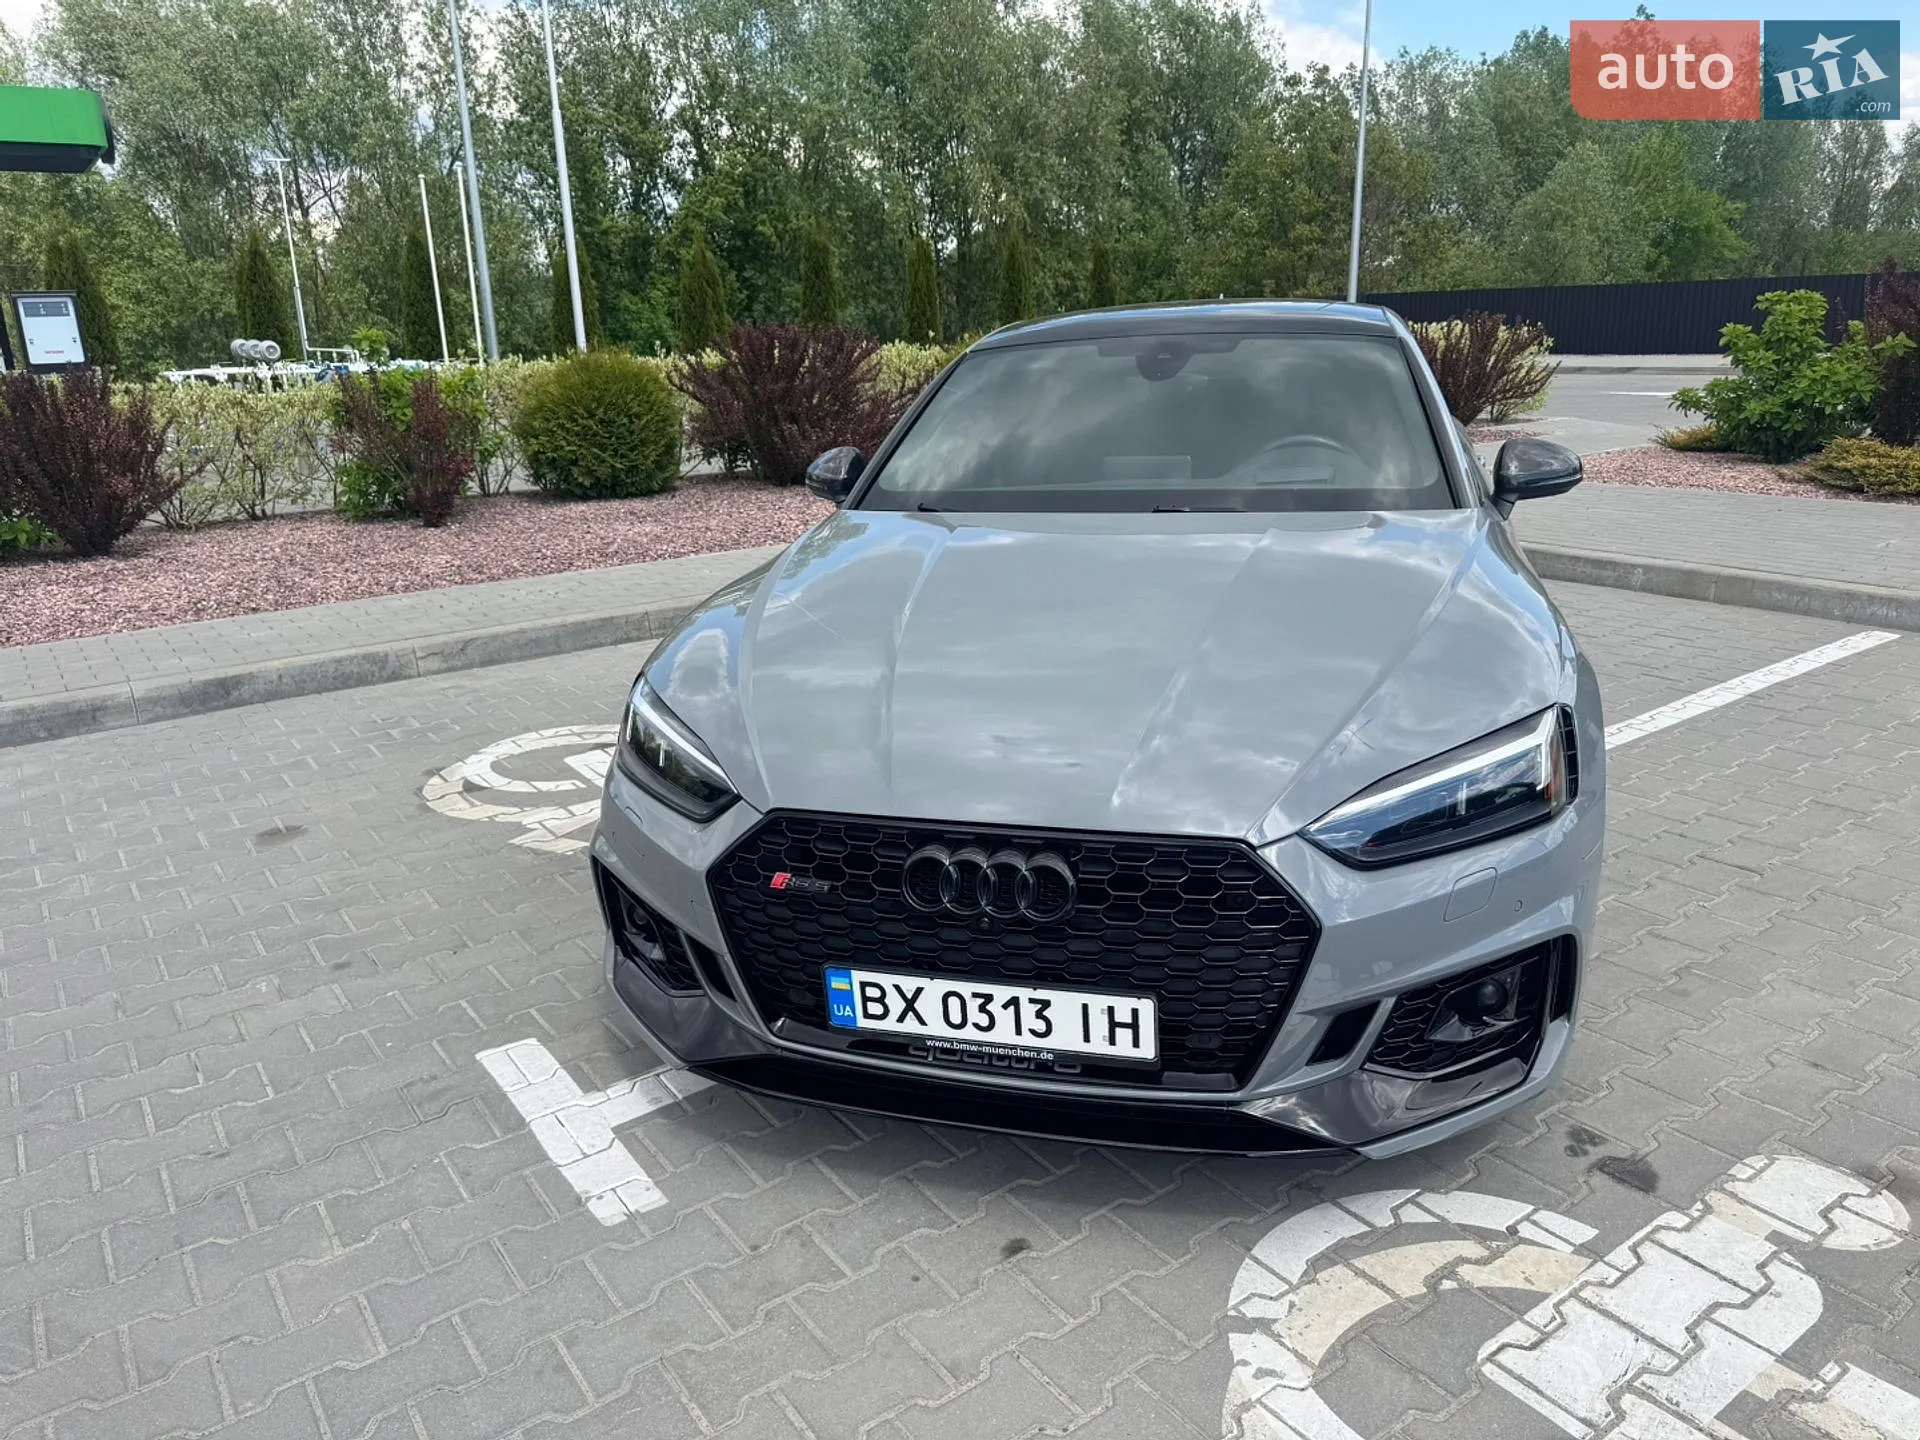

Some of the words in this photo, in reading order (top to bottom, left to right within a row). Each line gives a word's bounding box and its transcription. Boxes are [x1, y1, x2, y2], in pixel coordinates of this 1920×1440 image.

[833, 1005, 855, 1018] UA
[859, 980, 928, 1027] BX
[941, 990, 1053, 1039] 0313
[1081, 1002, 1140, 1049] IH
[925, 1038, 1055, 1061] www.bmw-muenchen.de
